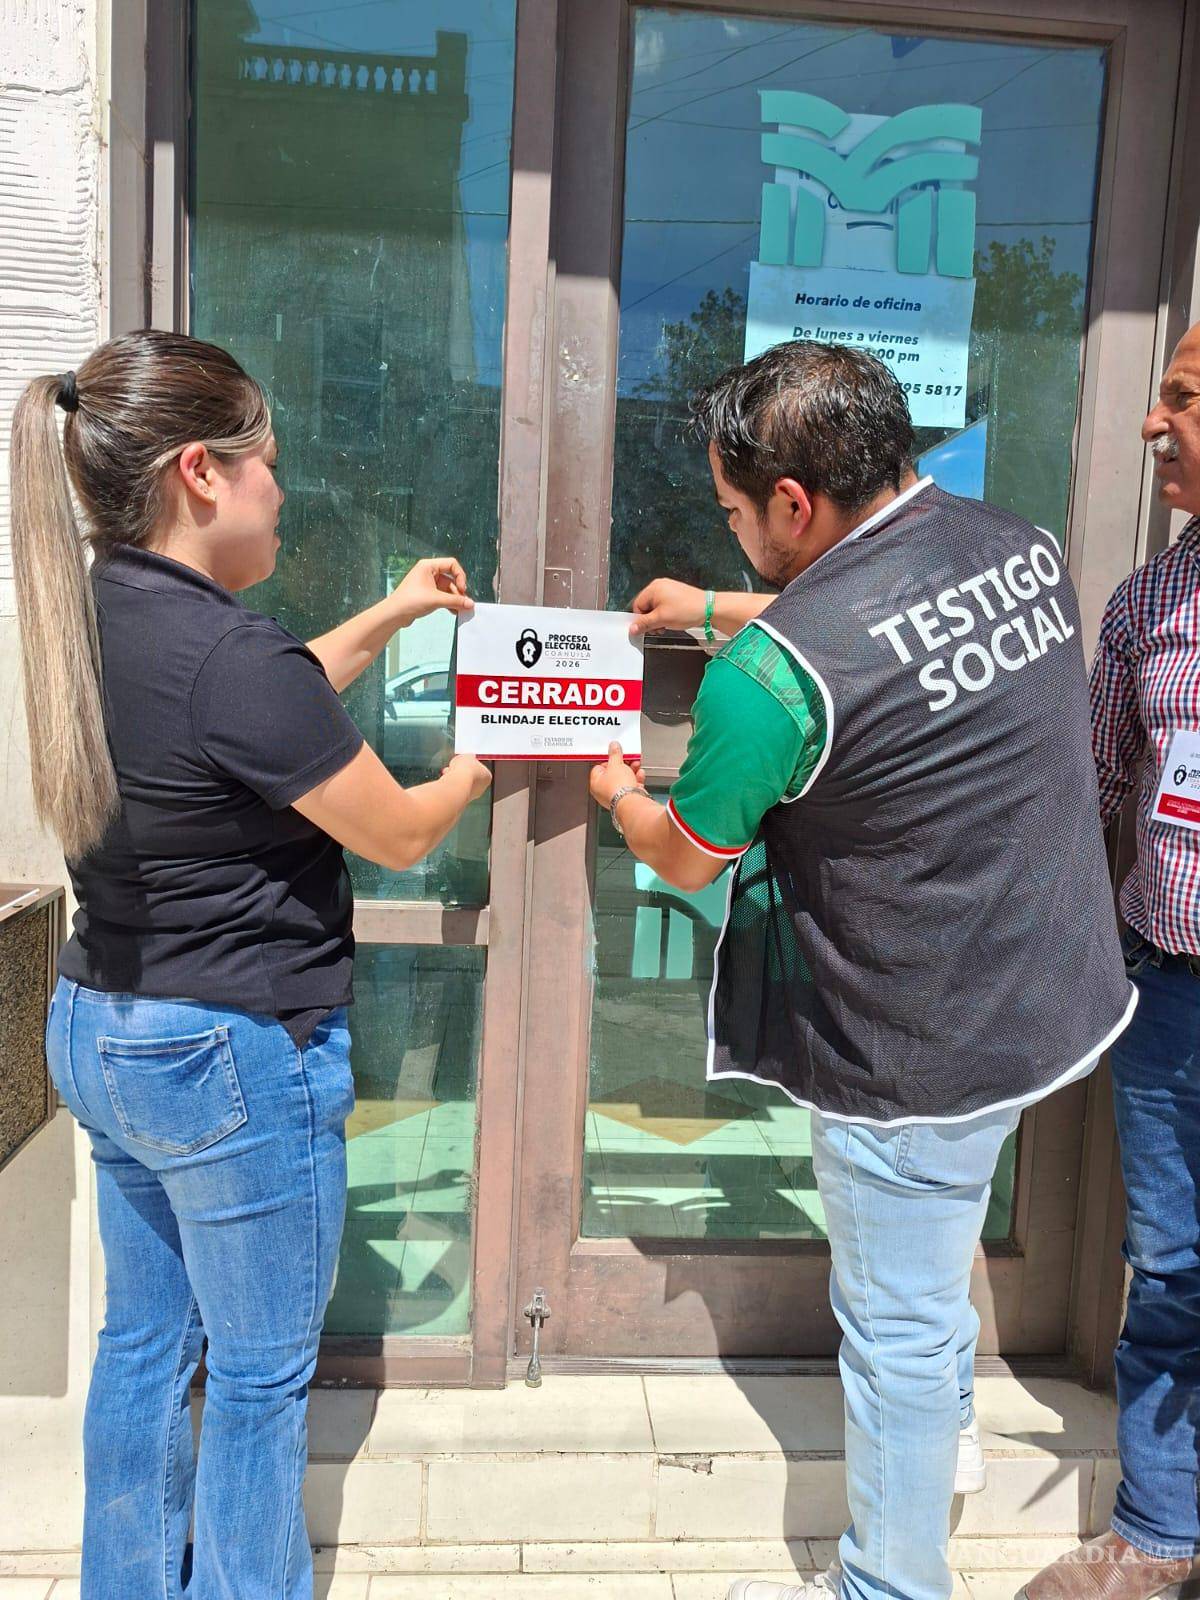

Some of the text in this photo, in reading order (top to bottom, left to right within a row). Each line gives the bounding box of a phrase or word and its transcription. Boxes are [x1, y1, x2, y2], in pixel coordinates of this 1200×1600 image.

[795, 293, 922, 312] Horario de oficina
[793, 327, 919, 345] De lunes a viernes
[897, 351, 920, 363] pm
[925, 385, 962, 396] 5817
[868, 544, 1061, 665] TESTIGO
[548, 634, 588, 643] PROCESO
[544, 641, 592, 651] ELECTORAL
[544, 650, 591, 658] COAHUILA
[918, 597, 1075, 712] SOCIAL
[555, 660, 580, 668] 2026
[477, 680, 626, 707] CERRADO
[481, 714, 621, 726] BLINDAJE ELECTORAL
